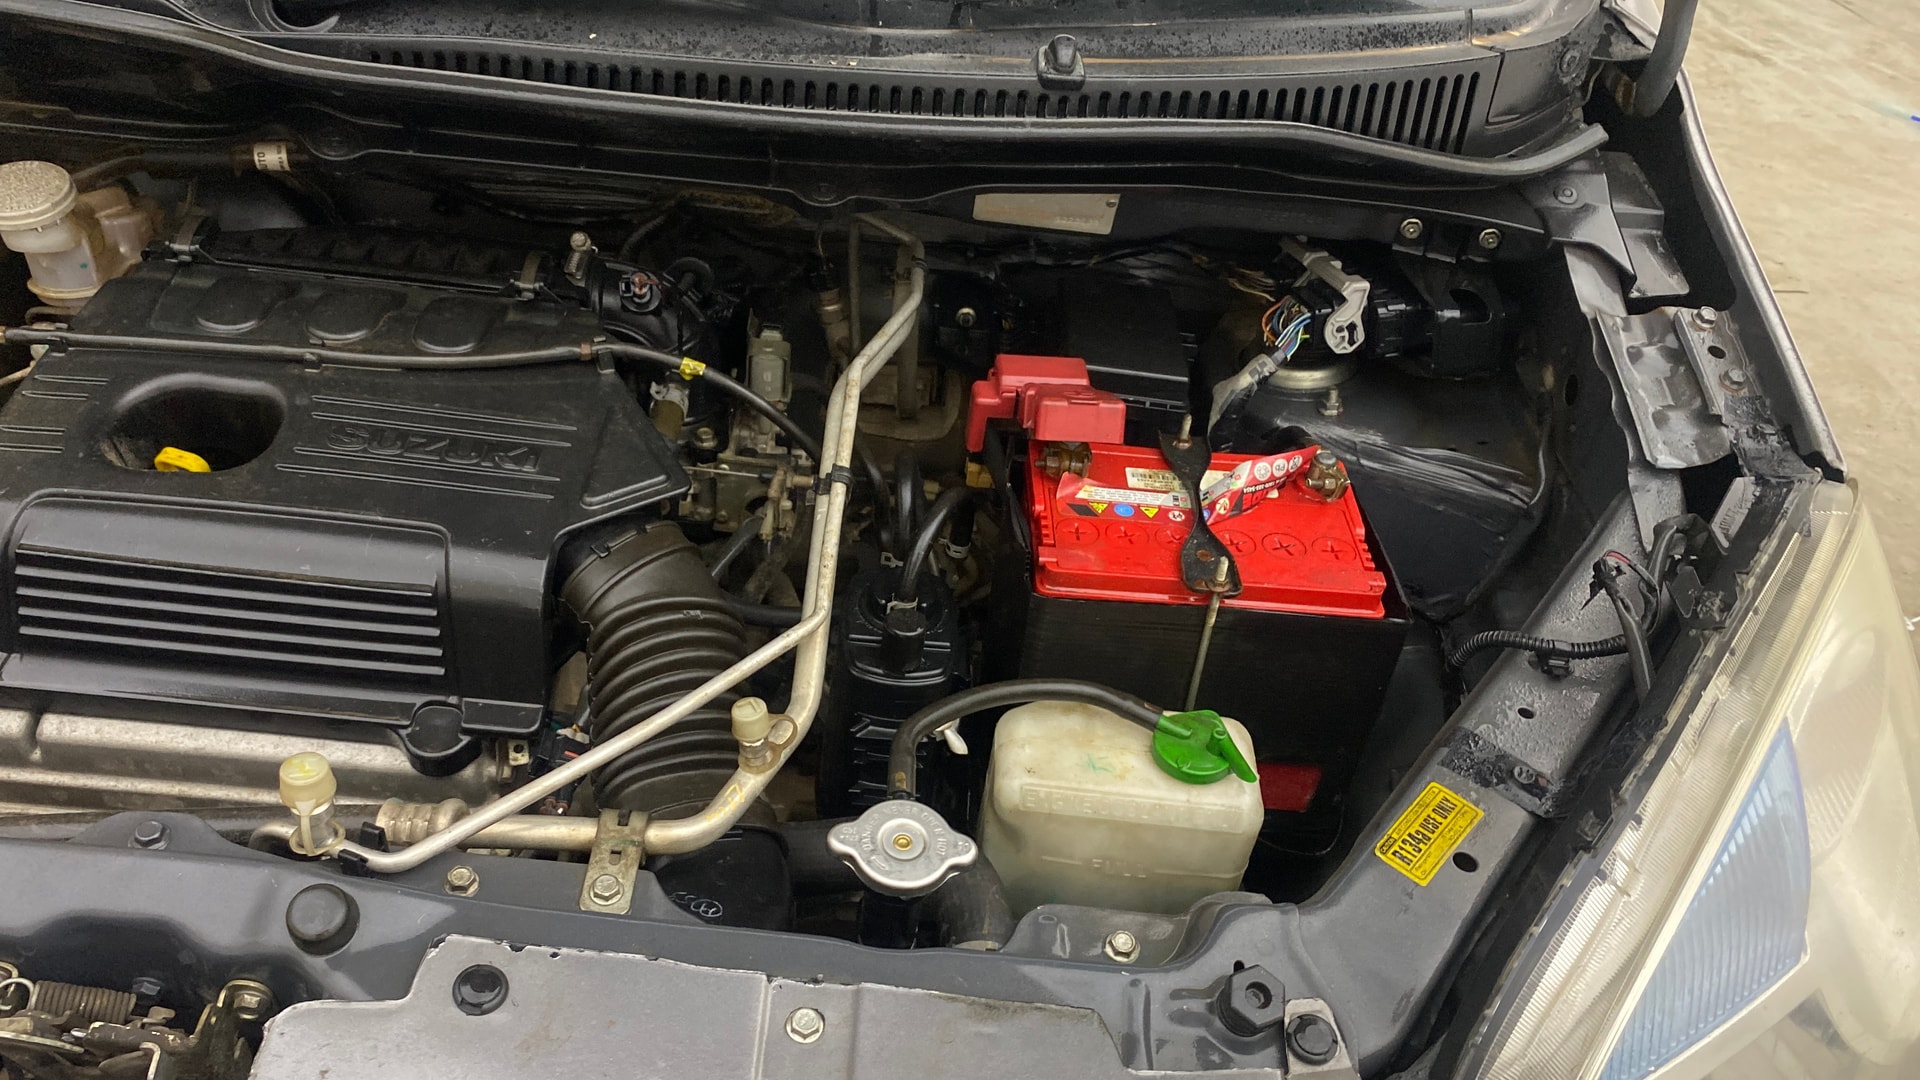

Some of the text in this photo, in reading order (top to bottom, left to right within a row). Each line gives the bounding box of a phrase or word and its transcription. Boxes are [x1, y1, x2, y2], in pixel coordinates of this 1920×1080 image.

[327, 425, 541, 472] SUZUKI
[1391, 829, 1432, 866] R134a
[1419, 814, 1443, 835] USE
[1431, 795, 1458, 820] ONLY
